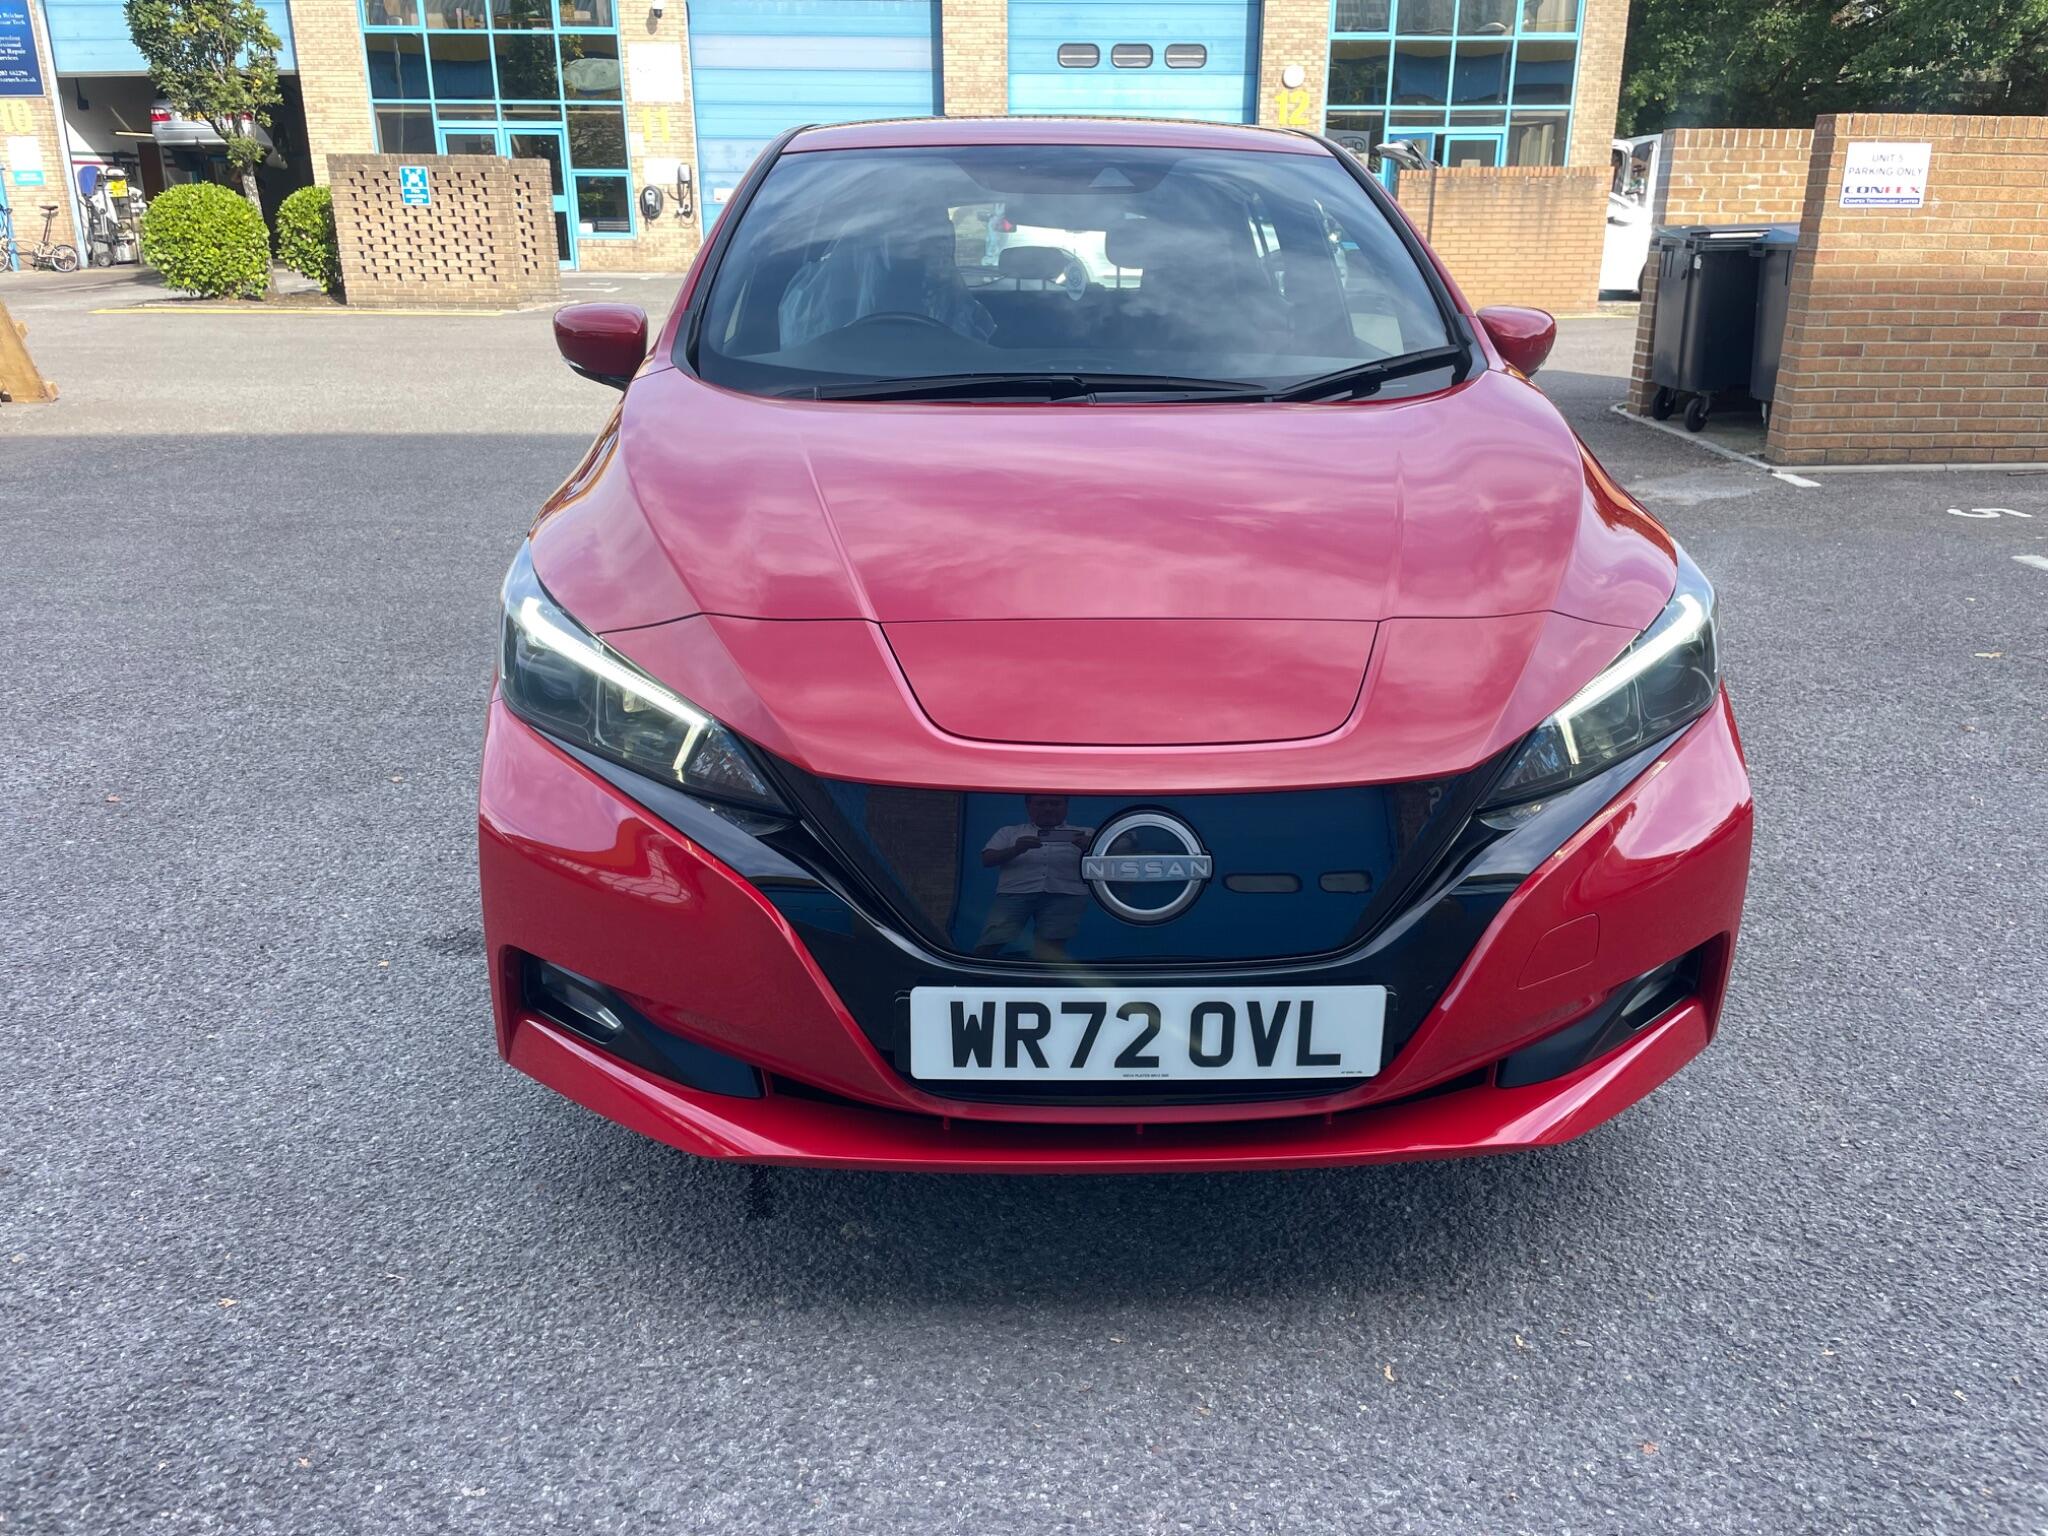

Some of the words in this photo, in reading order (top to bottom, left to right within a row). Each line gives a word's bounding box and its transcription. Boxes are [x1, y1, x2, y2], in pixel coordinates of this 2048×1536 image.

[0, 99, 33, 133] 10
[636, 106, 670, 142] 11
[1275, 89, 1310, 125] 12
[1848, 167, 1894, 176] PARKING
[1896, 167, 1924, 176] ONLY
[1872, 152, 1896, 162] UNIT
[1086, 861, 1209, 878] NISSAN
[950, 1001, 1162, 1069] WR72
[1188, 1001, 1341, 1067] OVL
